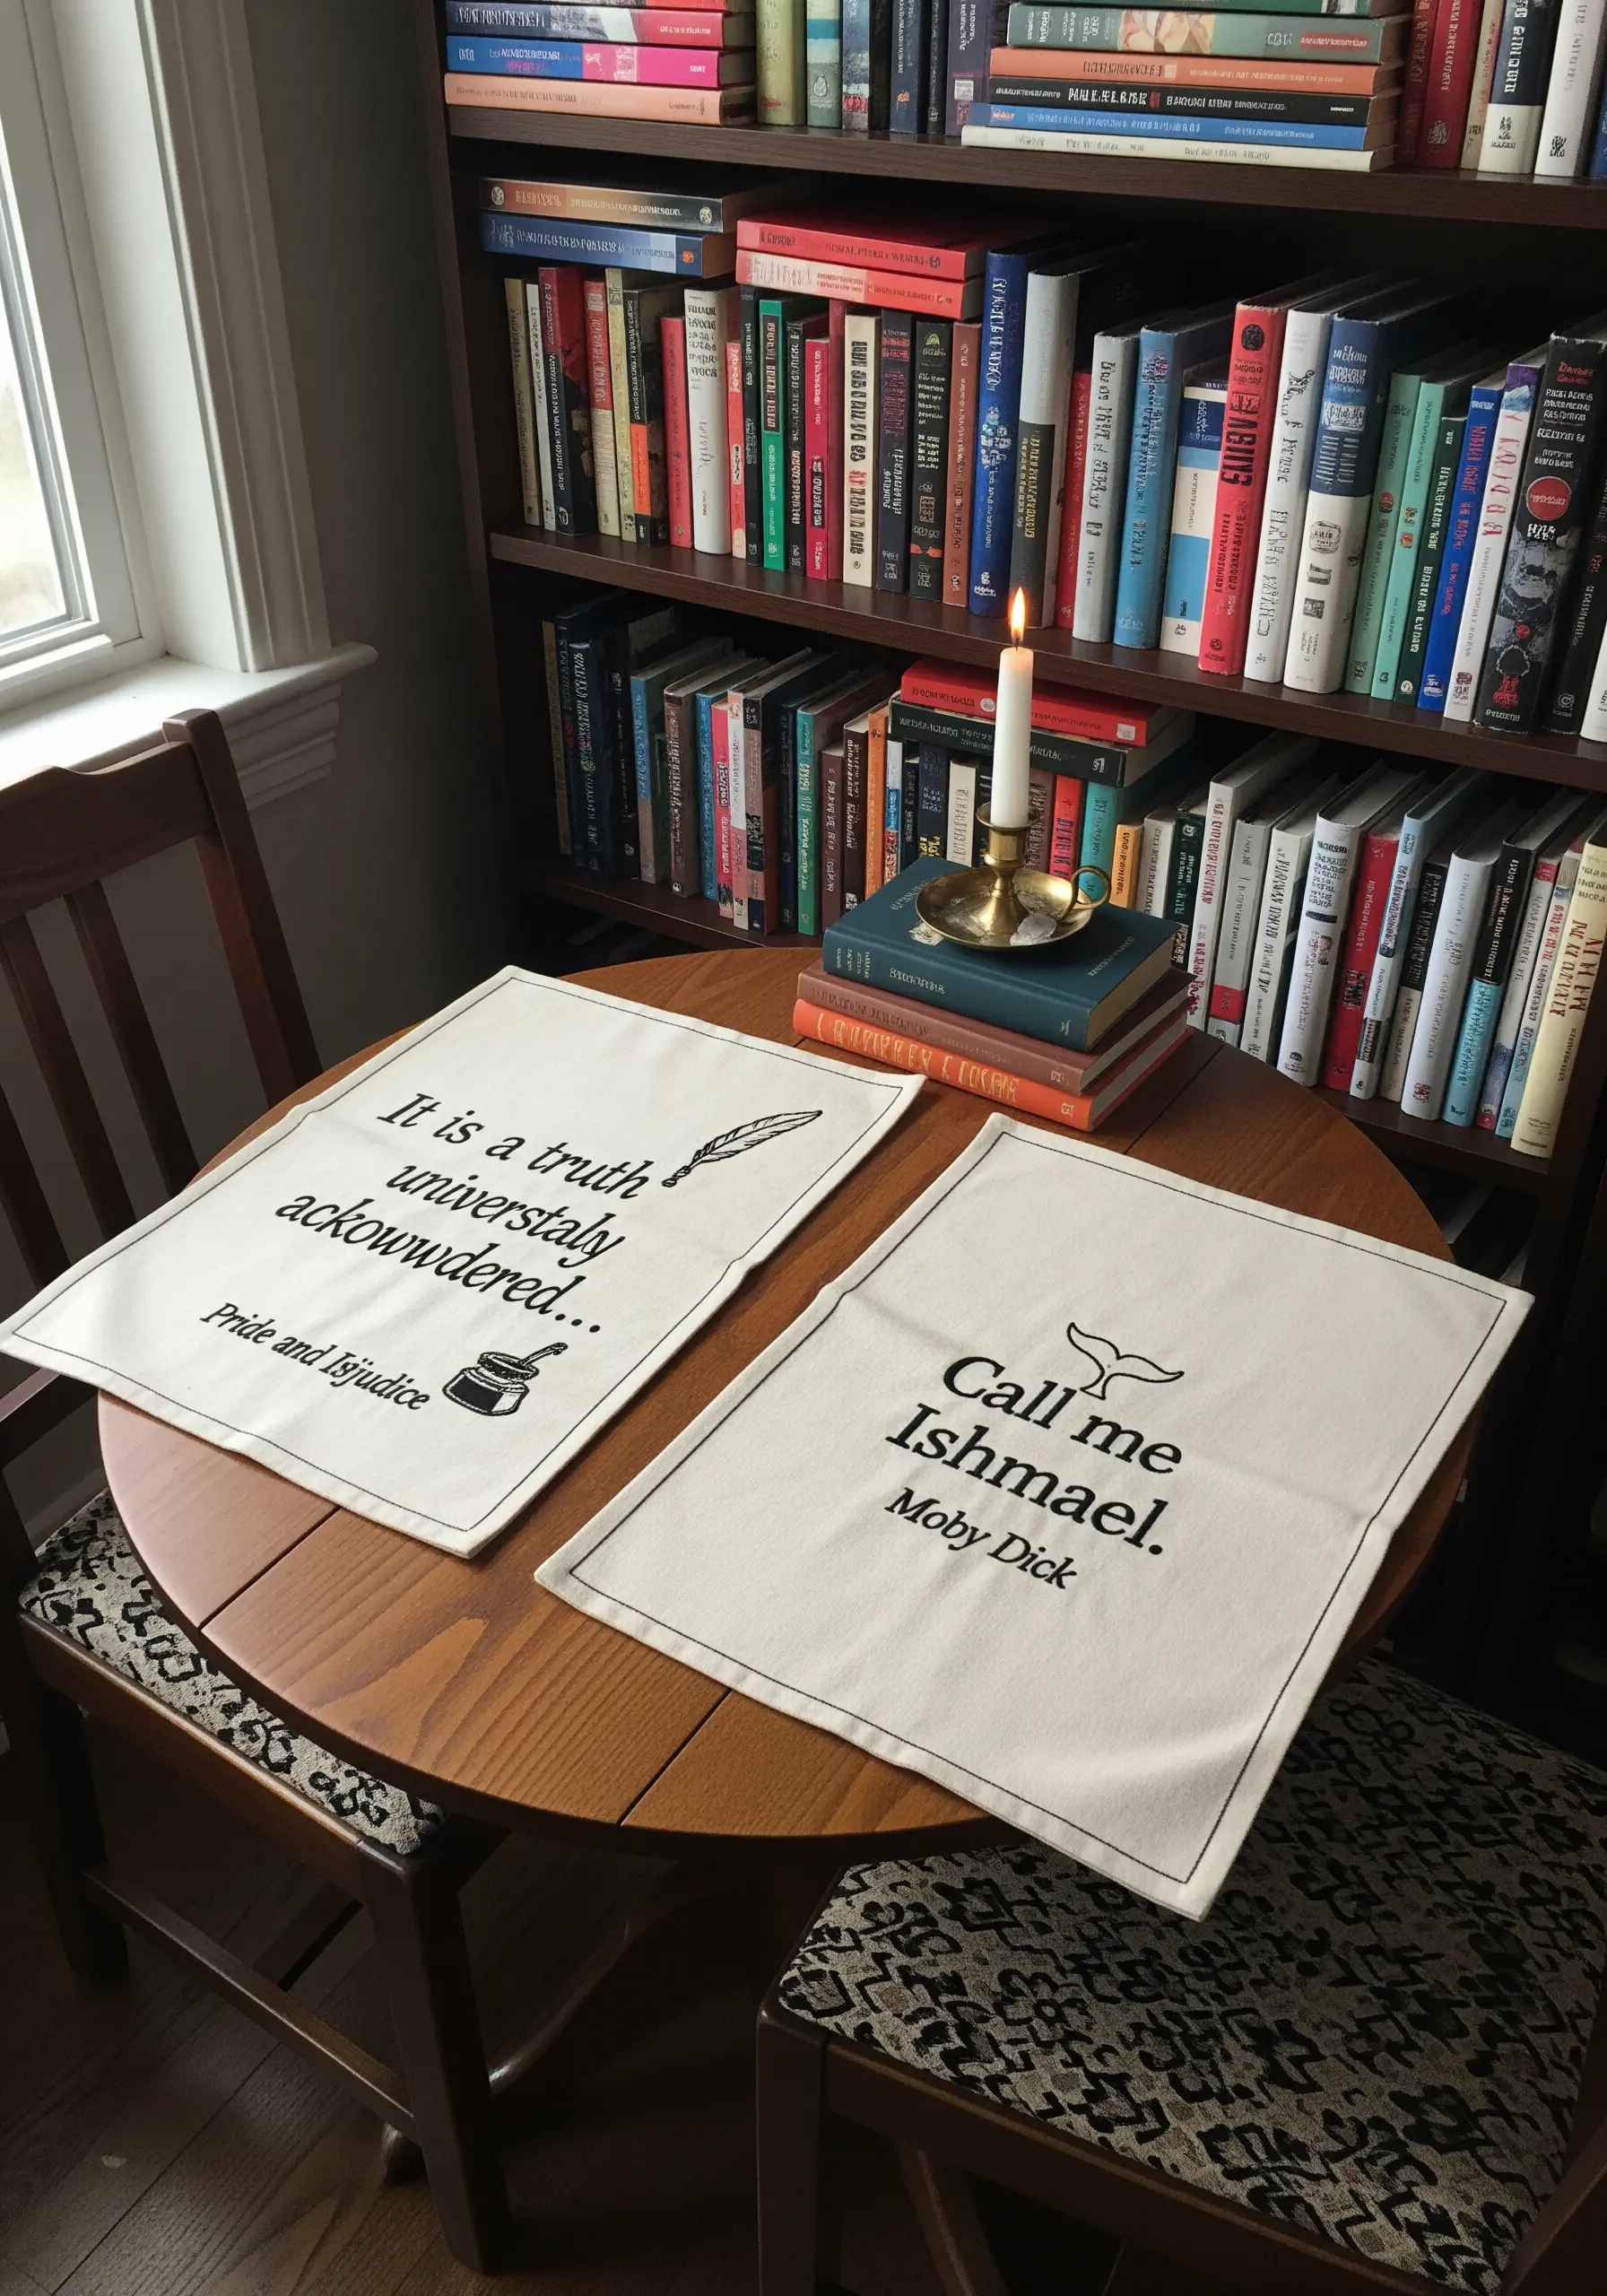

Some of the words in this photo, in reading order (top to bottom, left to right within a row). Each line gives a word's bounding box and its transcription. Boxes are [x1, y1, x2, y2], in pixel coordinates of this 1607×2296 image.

[377, 1092, 442, 1127] It
[432, 1109, 485, 1144] is
[485, 1136, 526, 1161] a
[527, 1142, 655, 1199] truth
[386, 1165, 626, 1269] universtaly
[199, 1302, 276, 1344] Pride
[271, 1336, 338, 1367] and
[942, 1356, 1078, 1430] Call
[1069, 1414, 1182, 1474] me
[884, 1403, 1169, 1555] Ishmael.
[883, 1487, 992, 1552] Moby
[986, 1532, 1078, 1589] Dick
